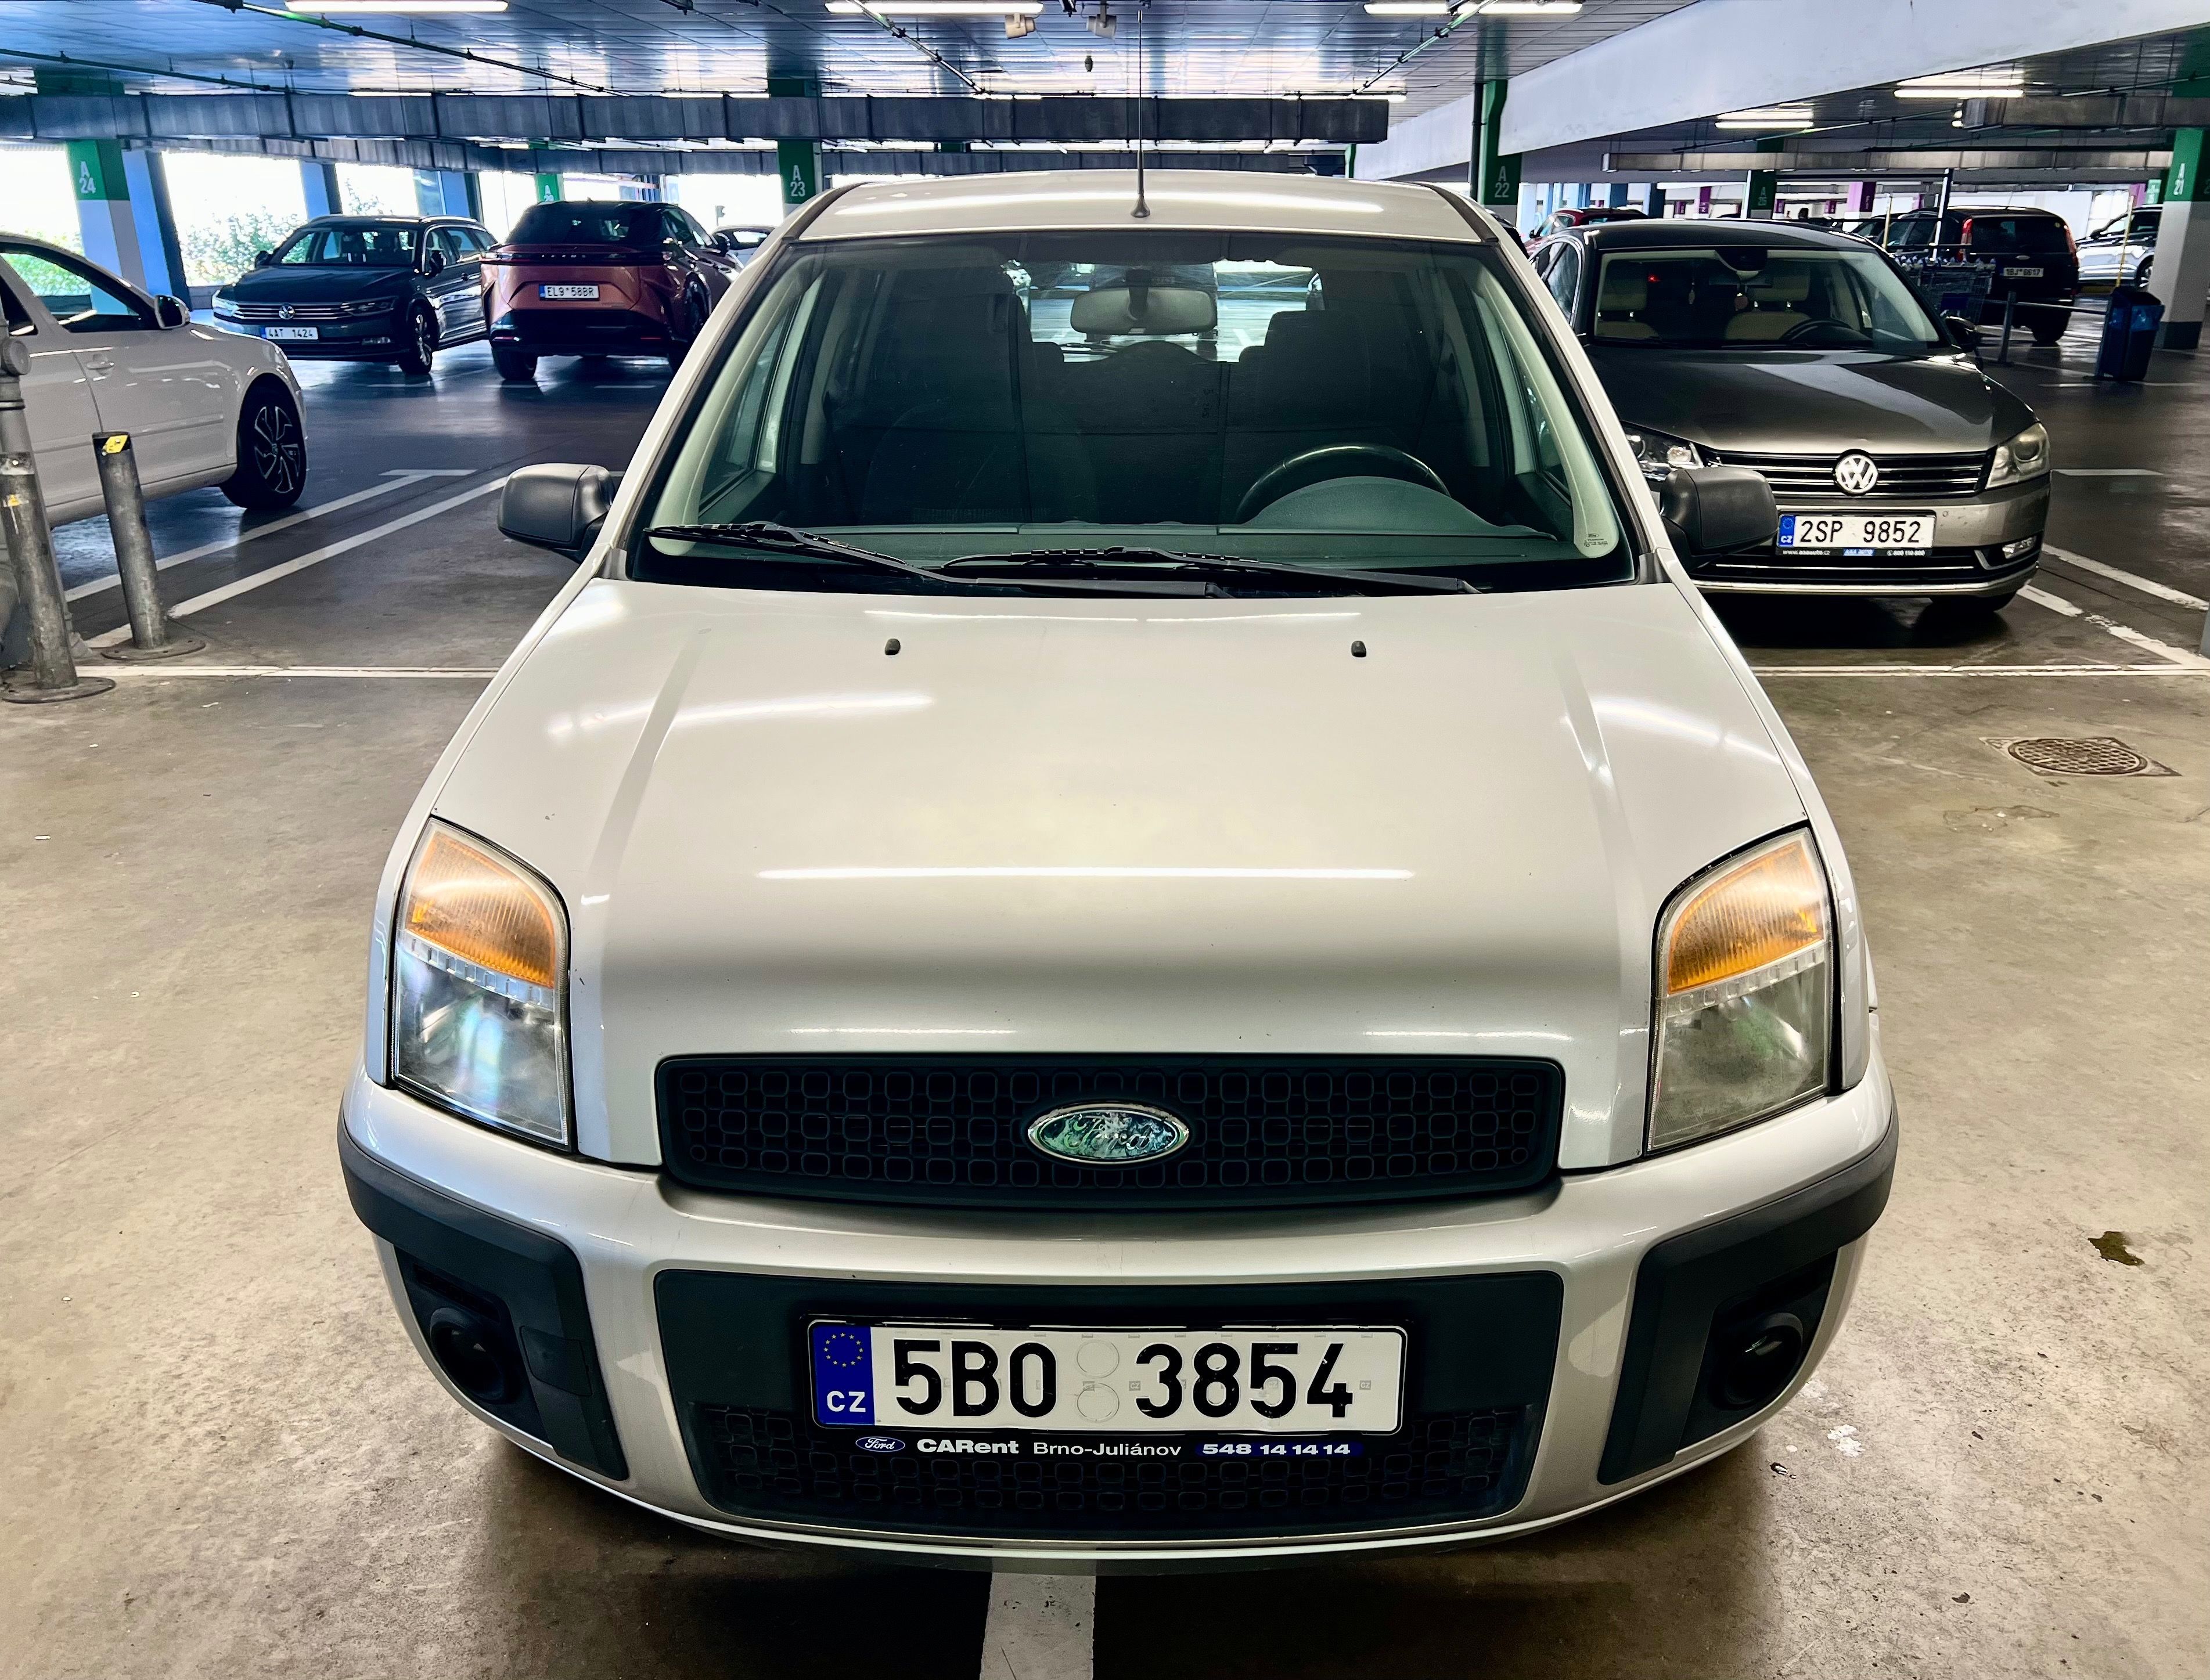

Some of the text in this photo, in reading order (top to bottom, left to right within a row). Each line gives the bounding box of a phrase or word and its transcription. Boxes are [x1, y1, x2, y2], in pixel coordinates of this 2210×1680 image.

[80, 161, 90, 178] A
[793, 165, 801, 181] A
[1498, 165, 1507, 182] A
[79, 176, 96, 193] 24
[790, 181, 805, 197] 23
[1495, 182, 1510, 198] 22
[547, 287, 564, 297] EL9
[268, 328, 283, 337] 4AT
[292, 329, 314, 338] 1424
[1780, 520, 1921, 543] CZ 2SP 9852
[826, 1338, 1354, 1419] CZ 5B0 3854
[865, 1437, 1351, 1455] Ford CARent Brno-Juliánov 548 14 14 14
